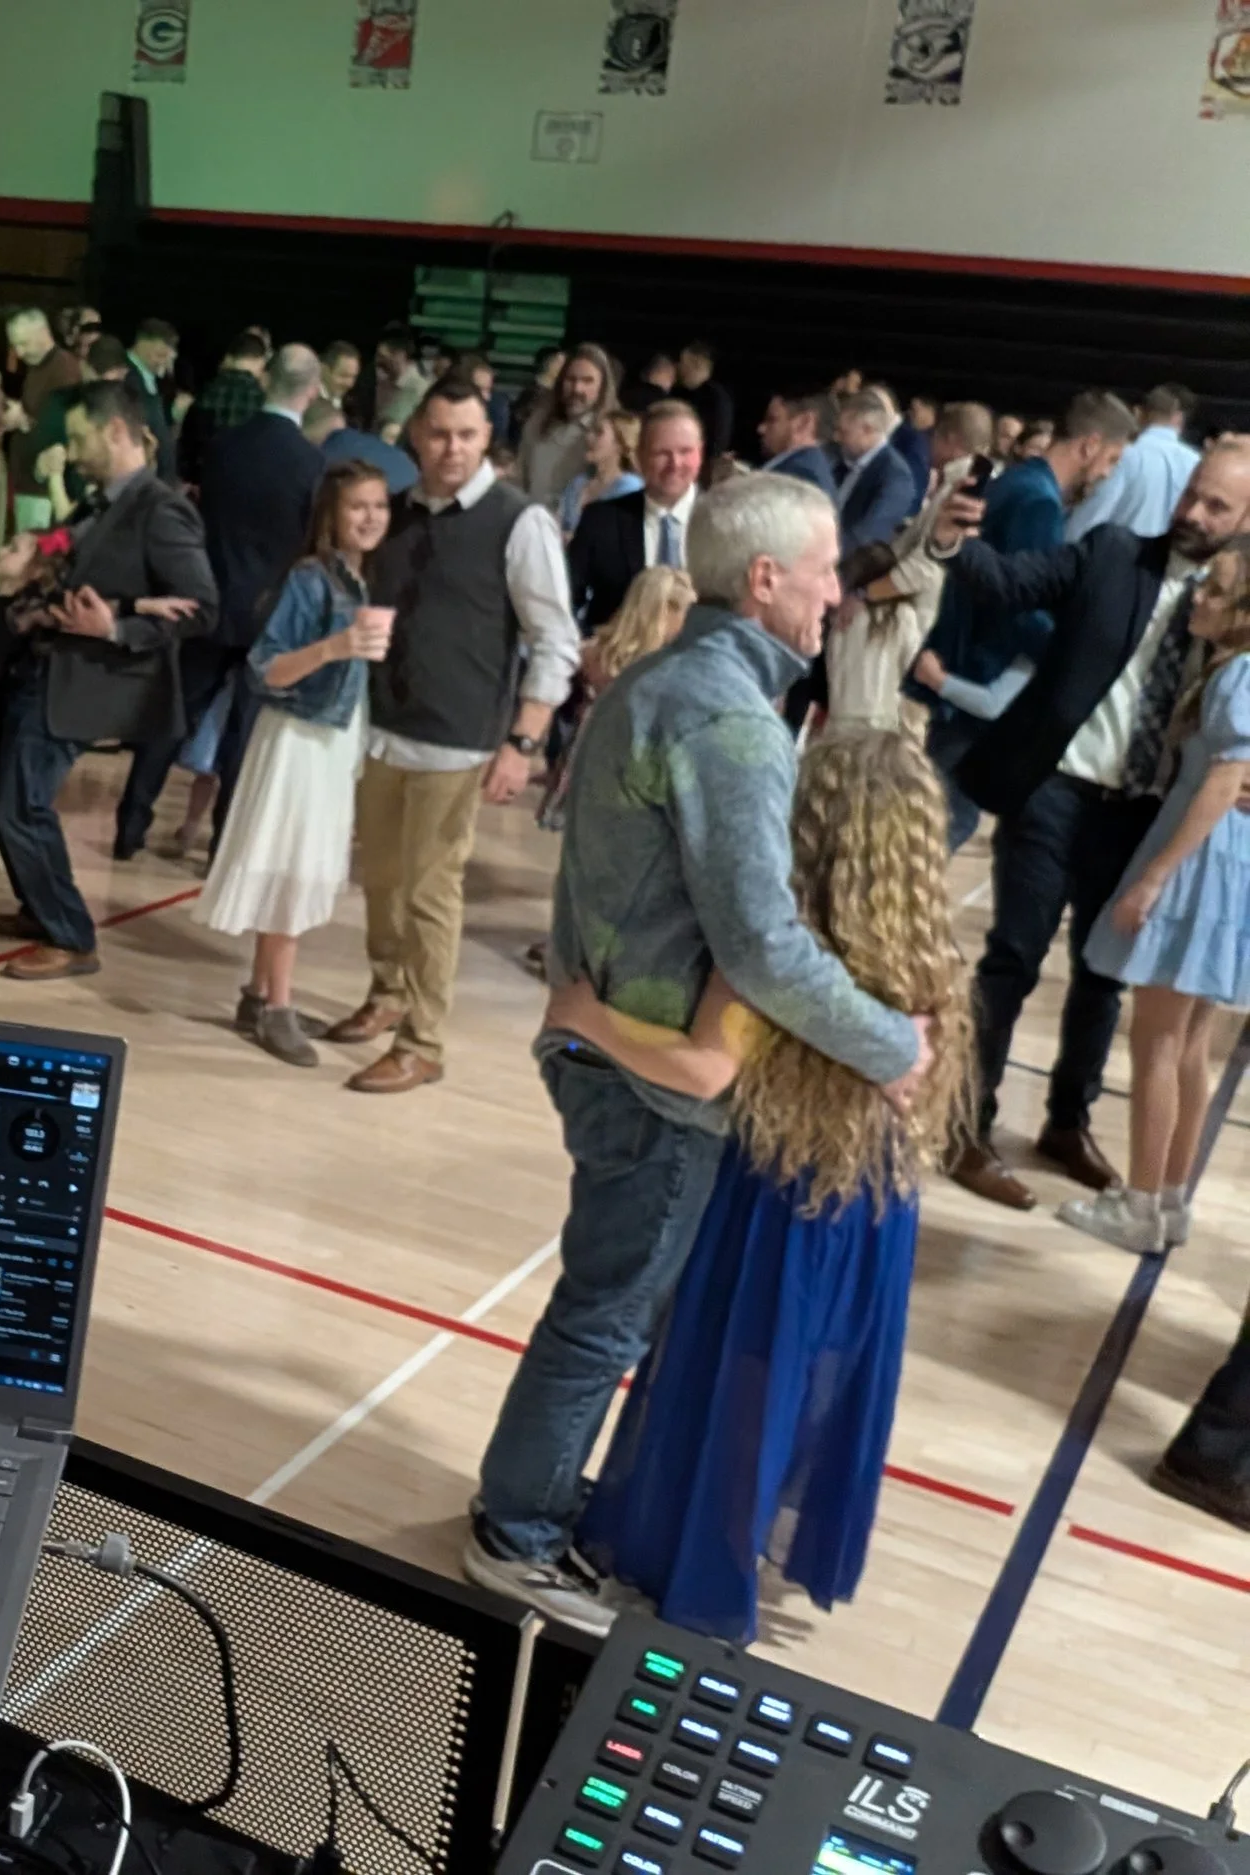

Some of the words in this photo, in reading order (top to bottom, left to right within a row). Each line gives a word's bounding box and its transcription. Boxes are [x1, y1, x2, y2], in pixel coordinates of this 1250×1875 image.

[662, 1762, 700, 1783] COLOR
[848, 1774, 929, 1824] ILS
[843, 1805, 918, 1842] COMMAND
[622, 1852, 662, 1875] COLOR
